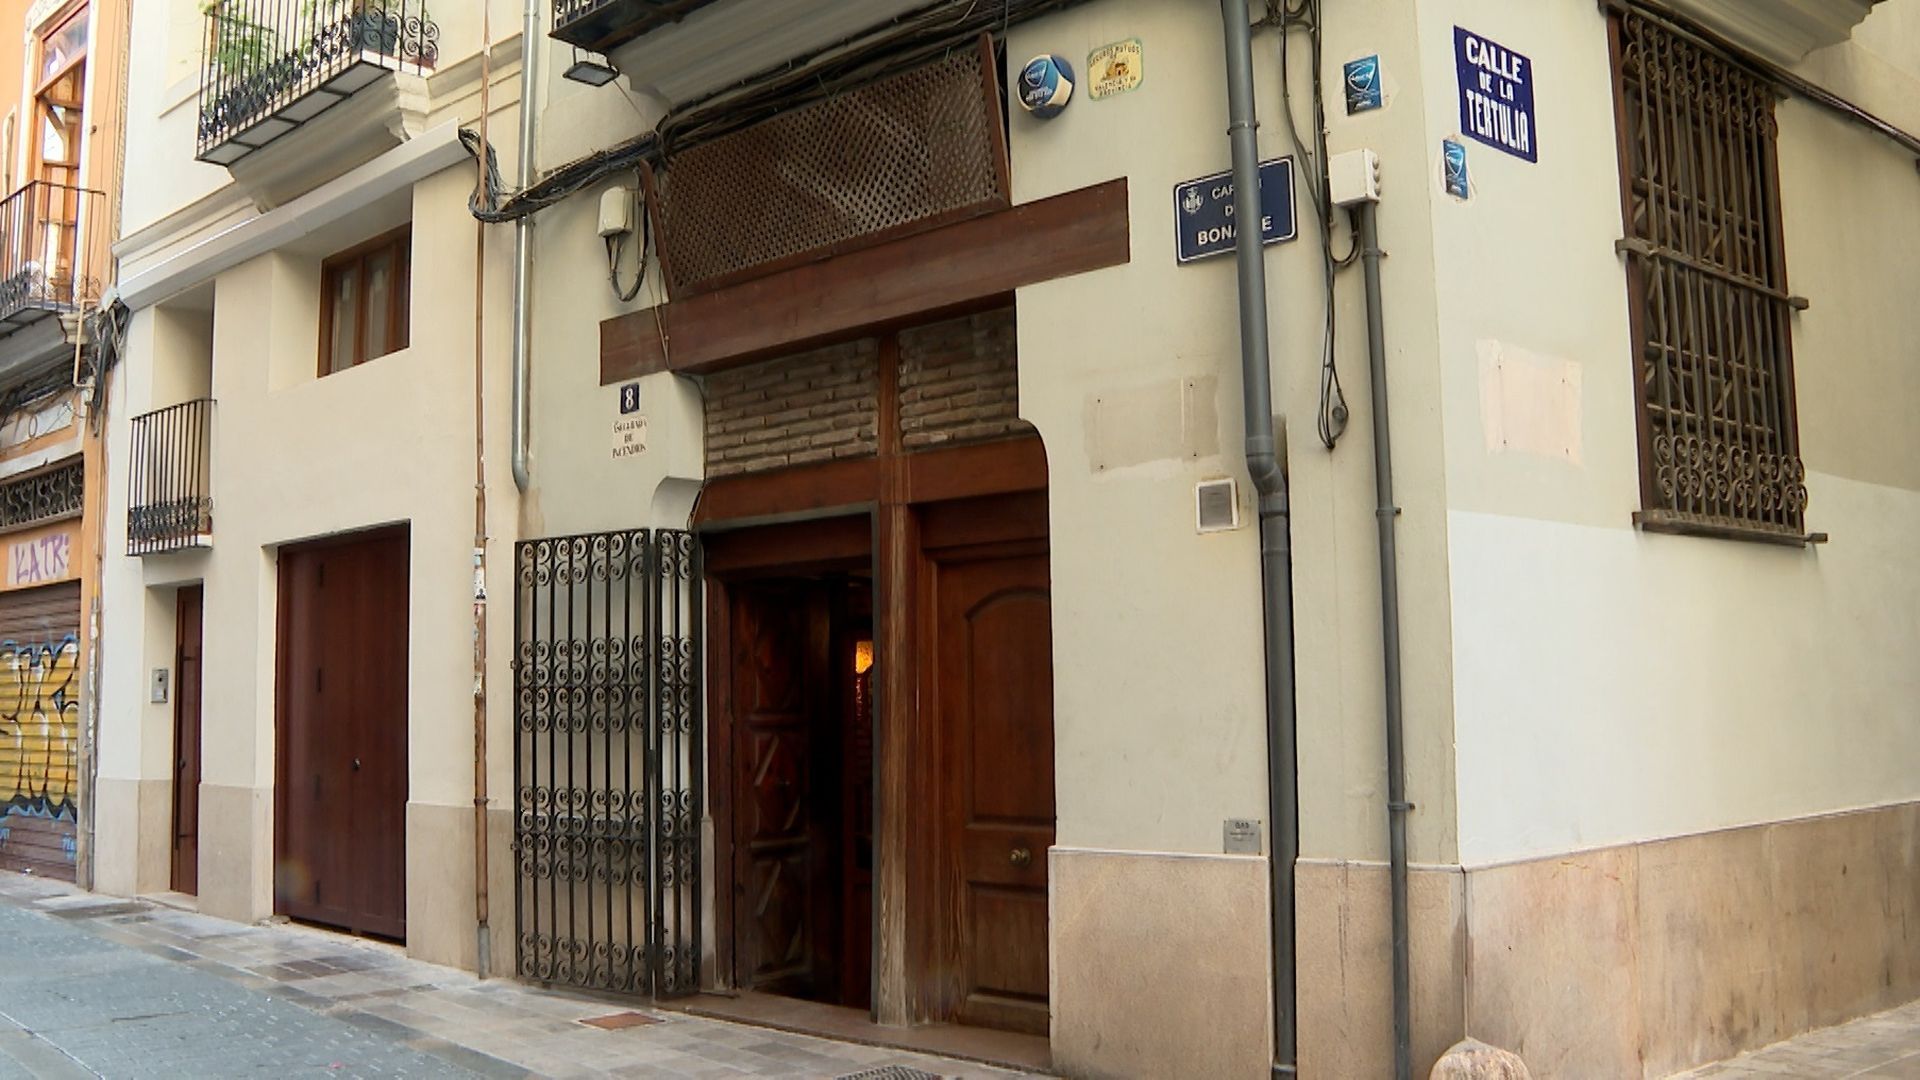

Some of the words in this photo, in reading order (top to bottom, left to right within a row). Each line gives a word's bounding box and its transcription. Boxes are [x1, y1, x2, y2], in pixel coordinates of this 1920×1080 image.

[1466, 36, 1522, 84] CALLE
[1479, 71, 1492, 93] DE
[1500, 79, 1513, 101] LA
[1466, 88, 1529, 153] TERTULIA
[625, 388, 634, 409] 8
